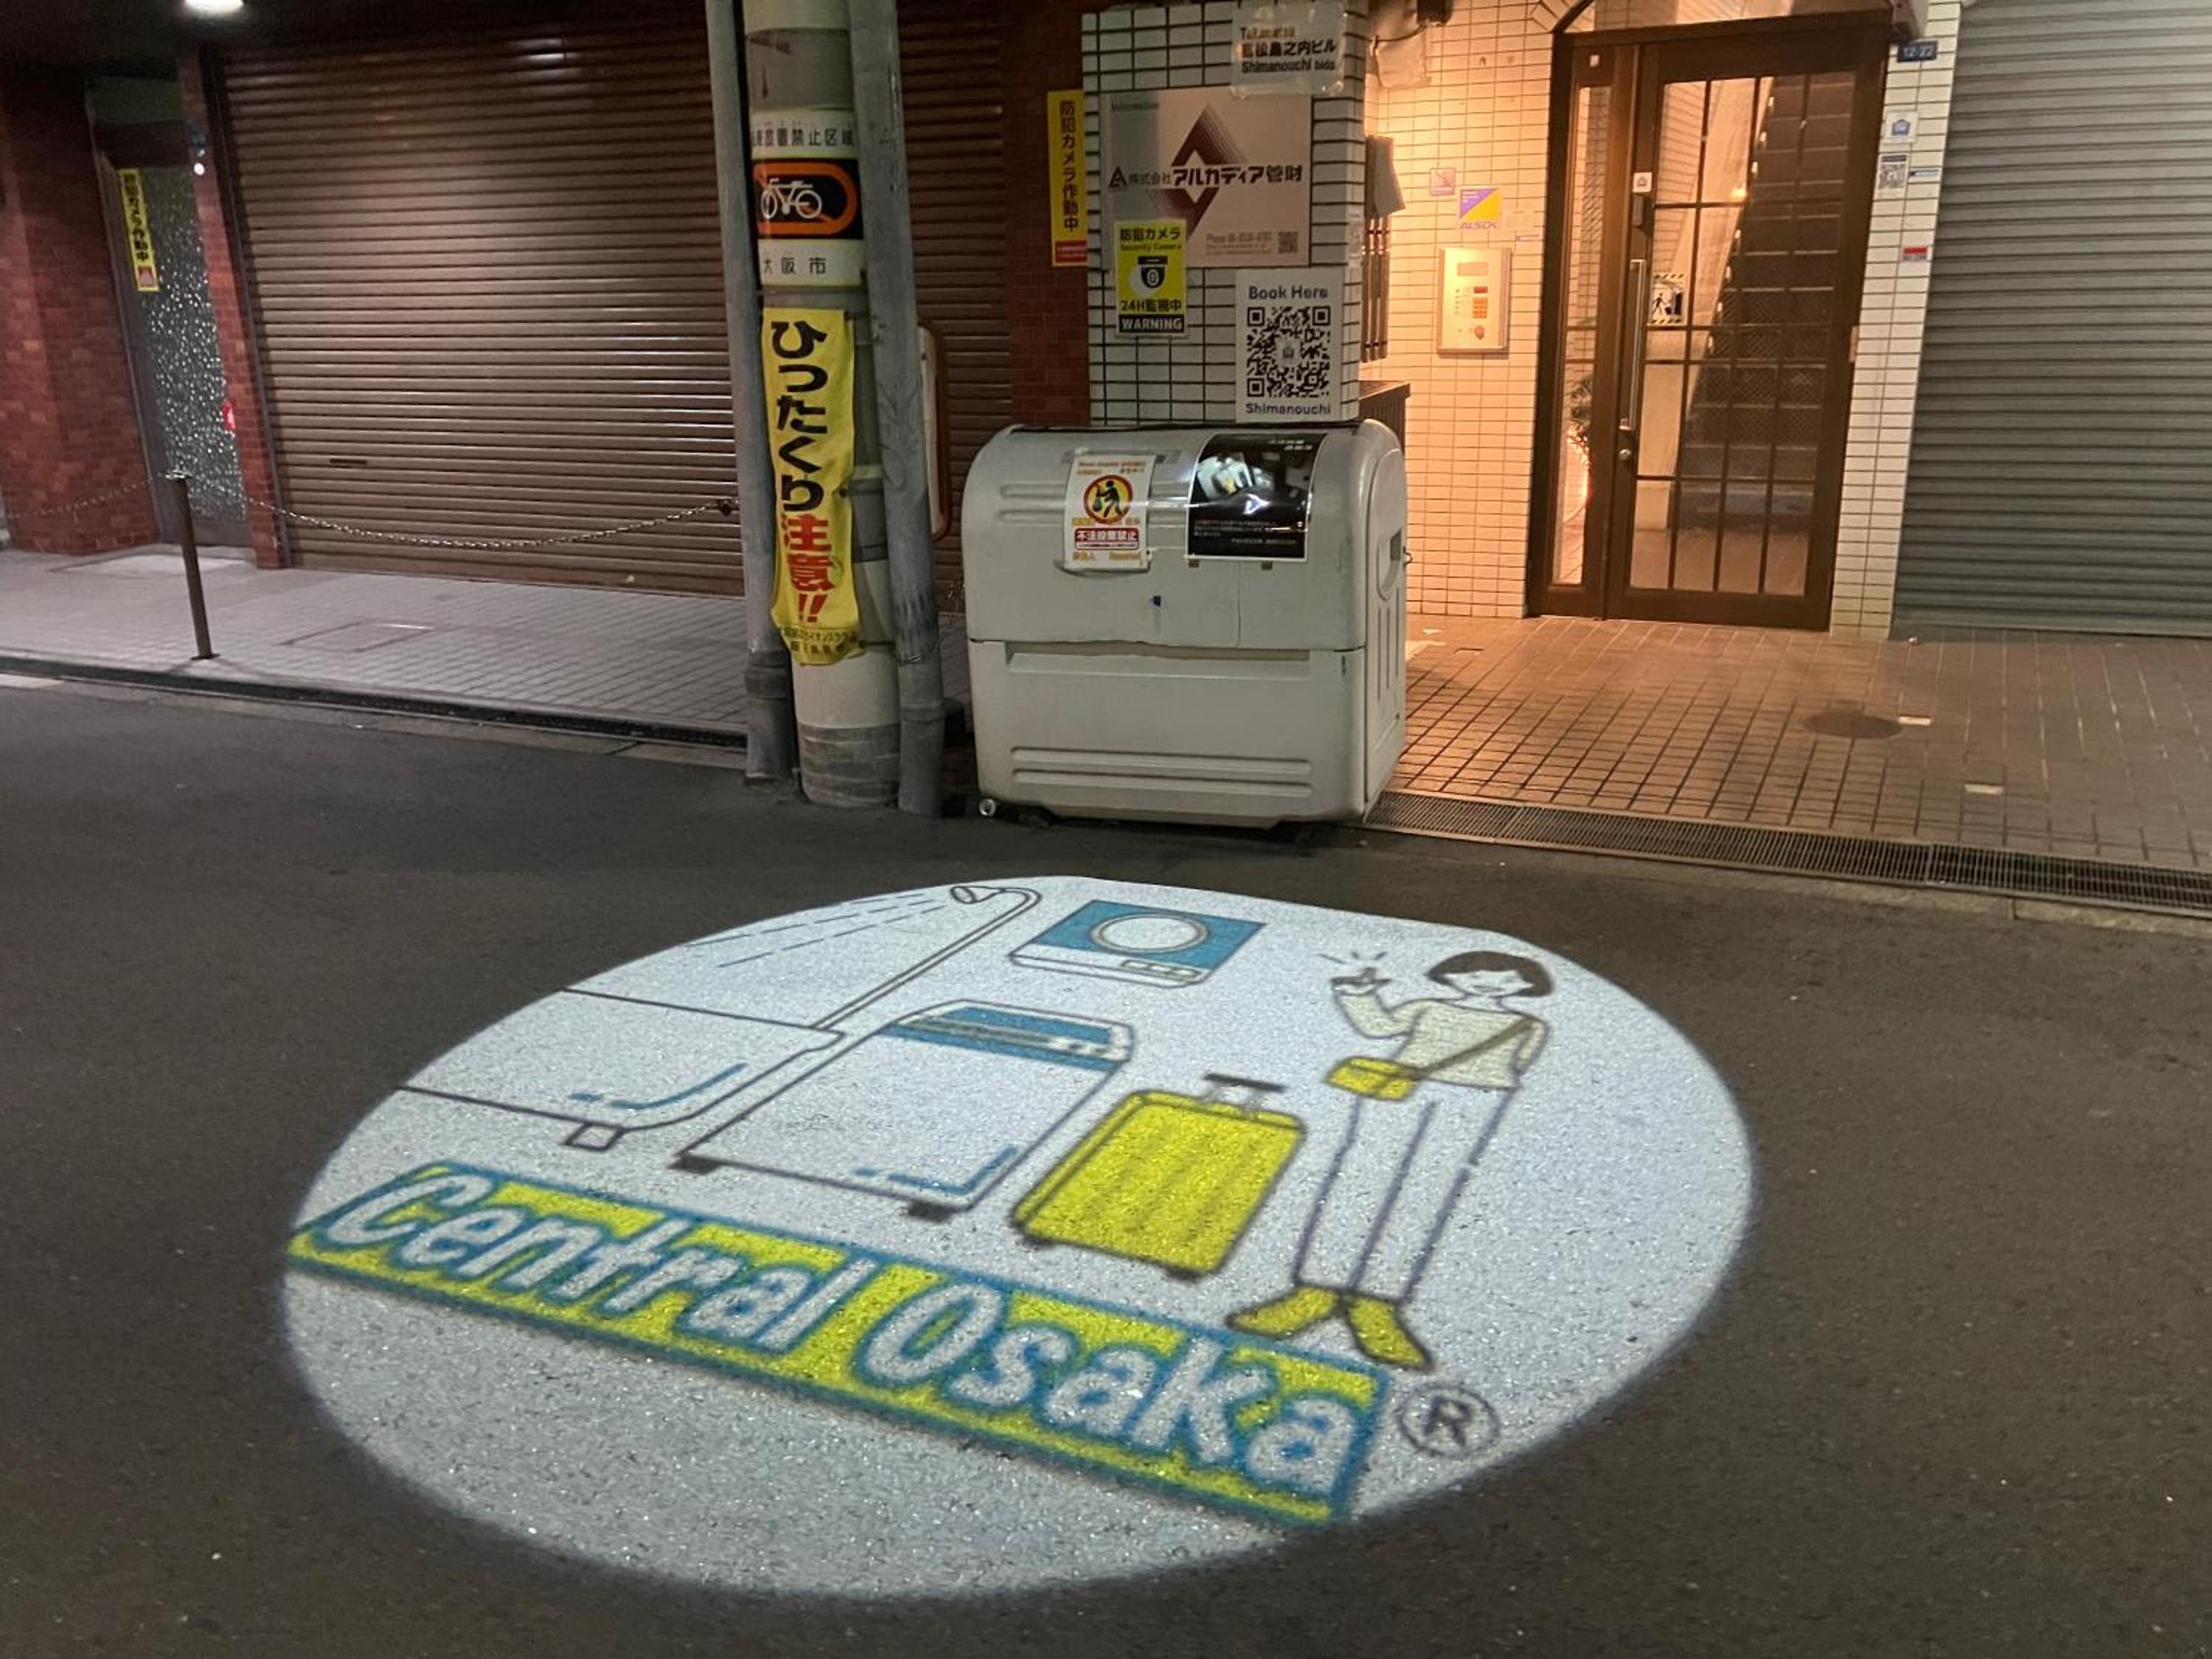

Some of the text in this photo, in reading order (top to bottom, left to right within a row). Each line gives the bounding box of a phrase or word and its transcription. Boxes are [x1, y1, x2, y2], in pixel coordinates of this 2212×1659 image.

[1060, 100, 1079, 232] 防犯カメラ作動中
[1120, 226, 1180, 241] 防犯カメラ
[764, 257, 827, 274] 大阪市
[1249, 285, 1329, 299] Book Here
[1121, 317, 1183, 330] WARNING
[1246, 403, 1331, 416] Shimanouchi
[321, 1171, 879, 1352] Central
[862, 1280, 1361, 1497] Osaka
